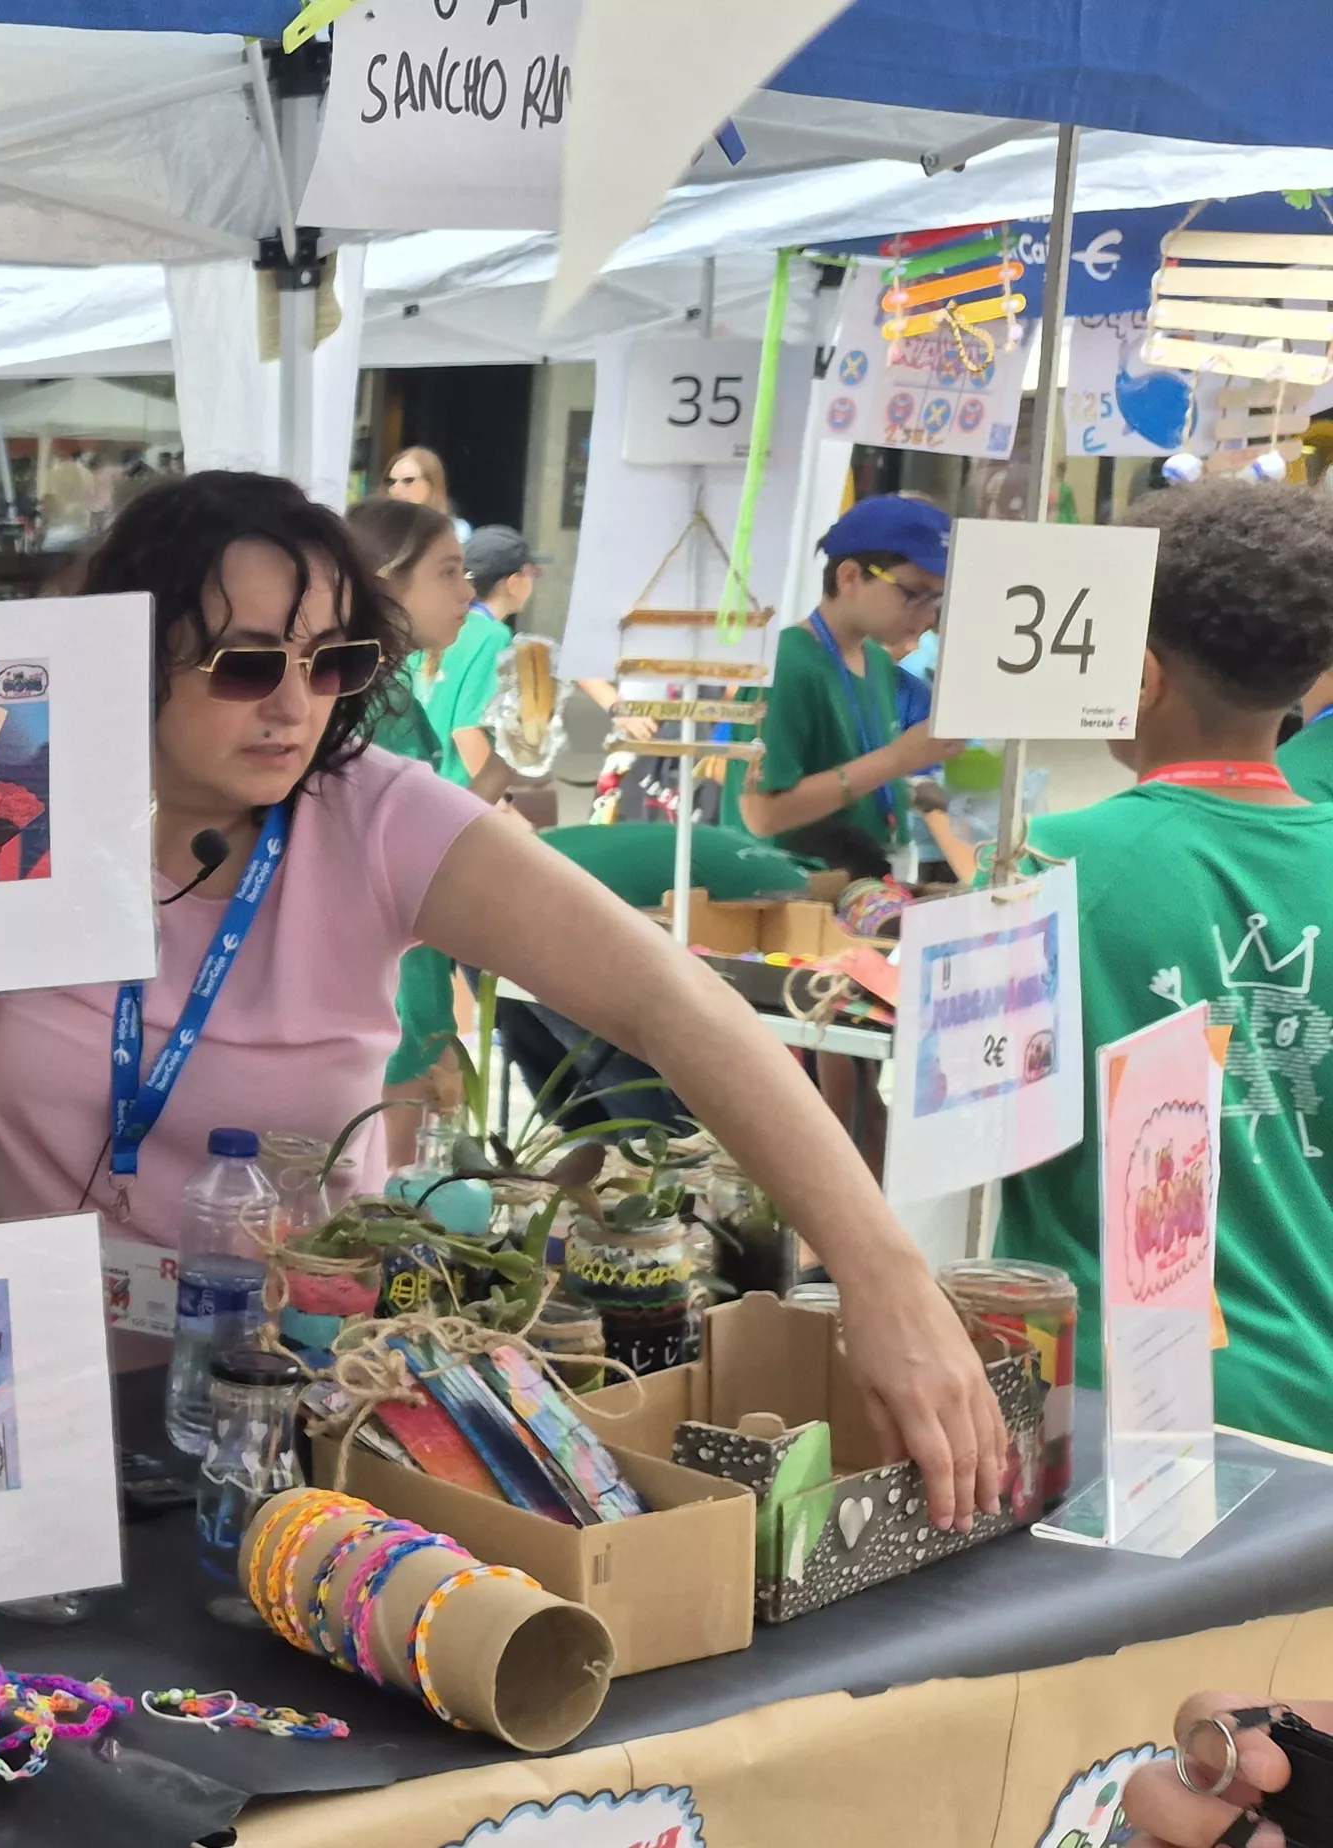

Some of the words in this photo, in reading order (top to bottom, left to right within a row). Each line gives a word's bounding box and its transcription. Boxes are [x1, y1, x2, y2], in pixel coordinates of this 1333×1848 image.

[361, 46, 507, 124] SANCHO
[666, 374, 743, 427] 35
[996, 584, 1096, 675] 34
[983, 1033, 1008, 1067] 2€
